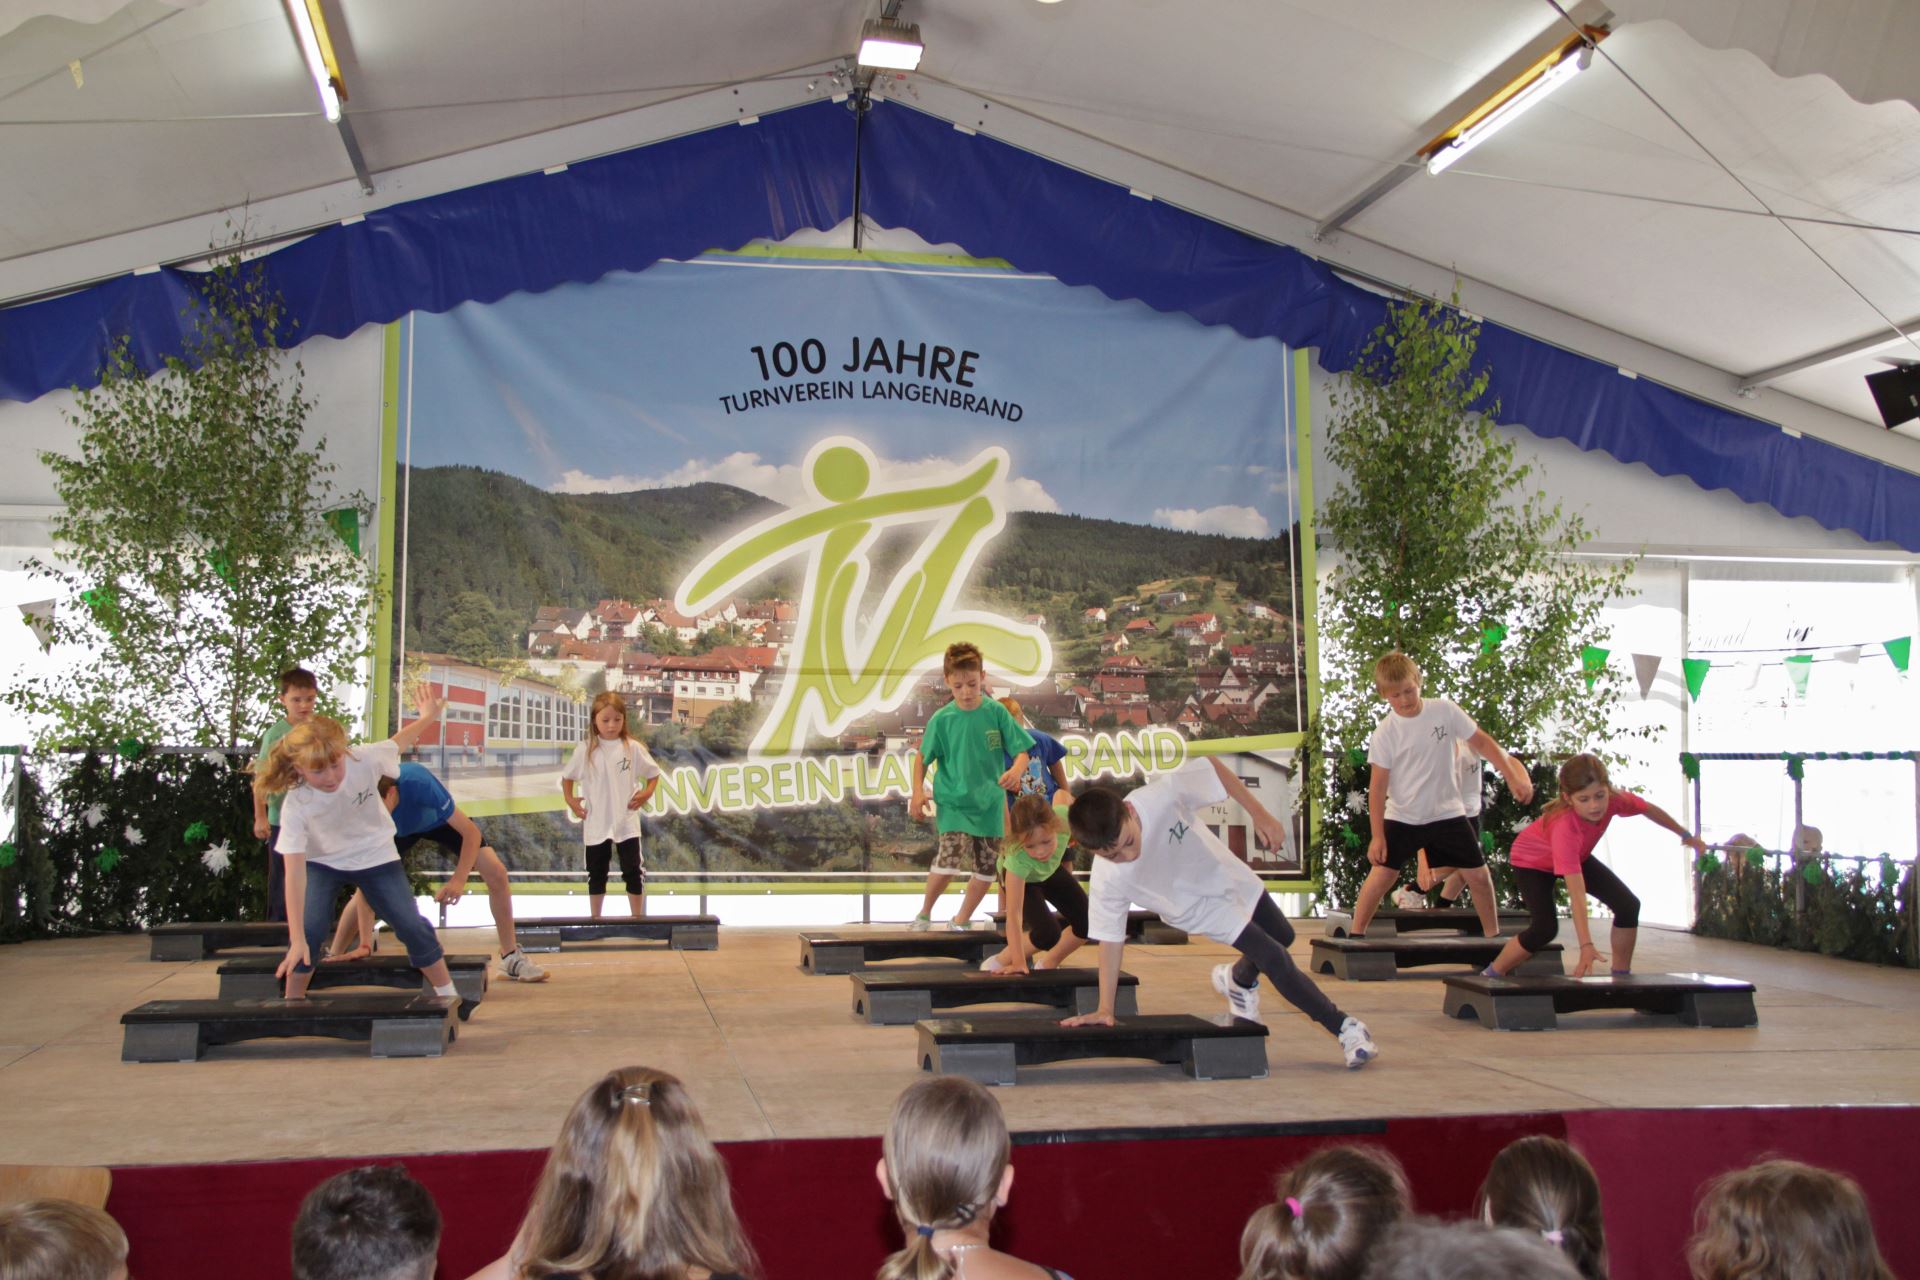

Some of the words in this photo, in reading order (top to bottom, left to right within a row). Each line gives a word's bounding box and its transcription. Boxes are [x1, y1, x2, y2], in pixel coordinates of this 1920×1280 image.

[750, 337, 827, 381] 100
[842, 336, 980, 388] JAHRE
[719, 380, 854, 415] TURNVEREIN
[861, 380, 1024, 422] LANGENBRAND
[1210, 805, 1229, 815] TVL
